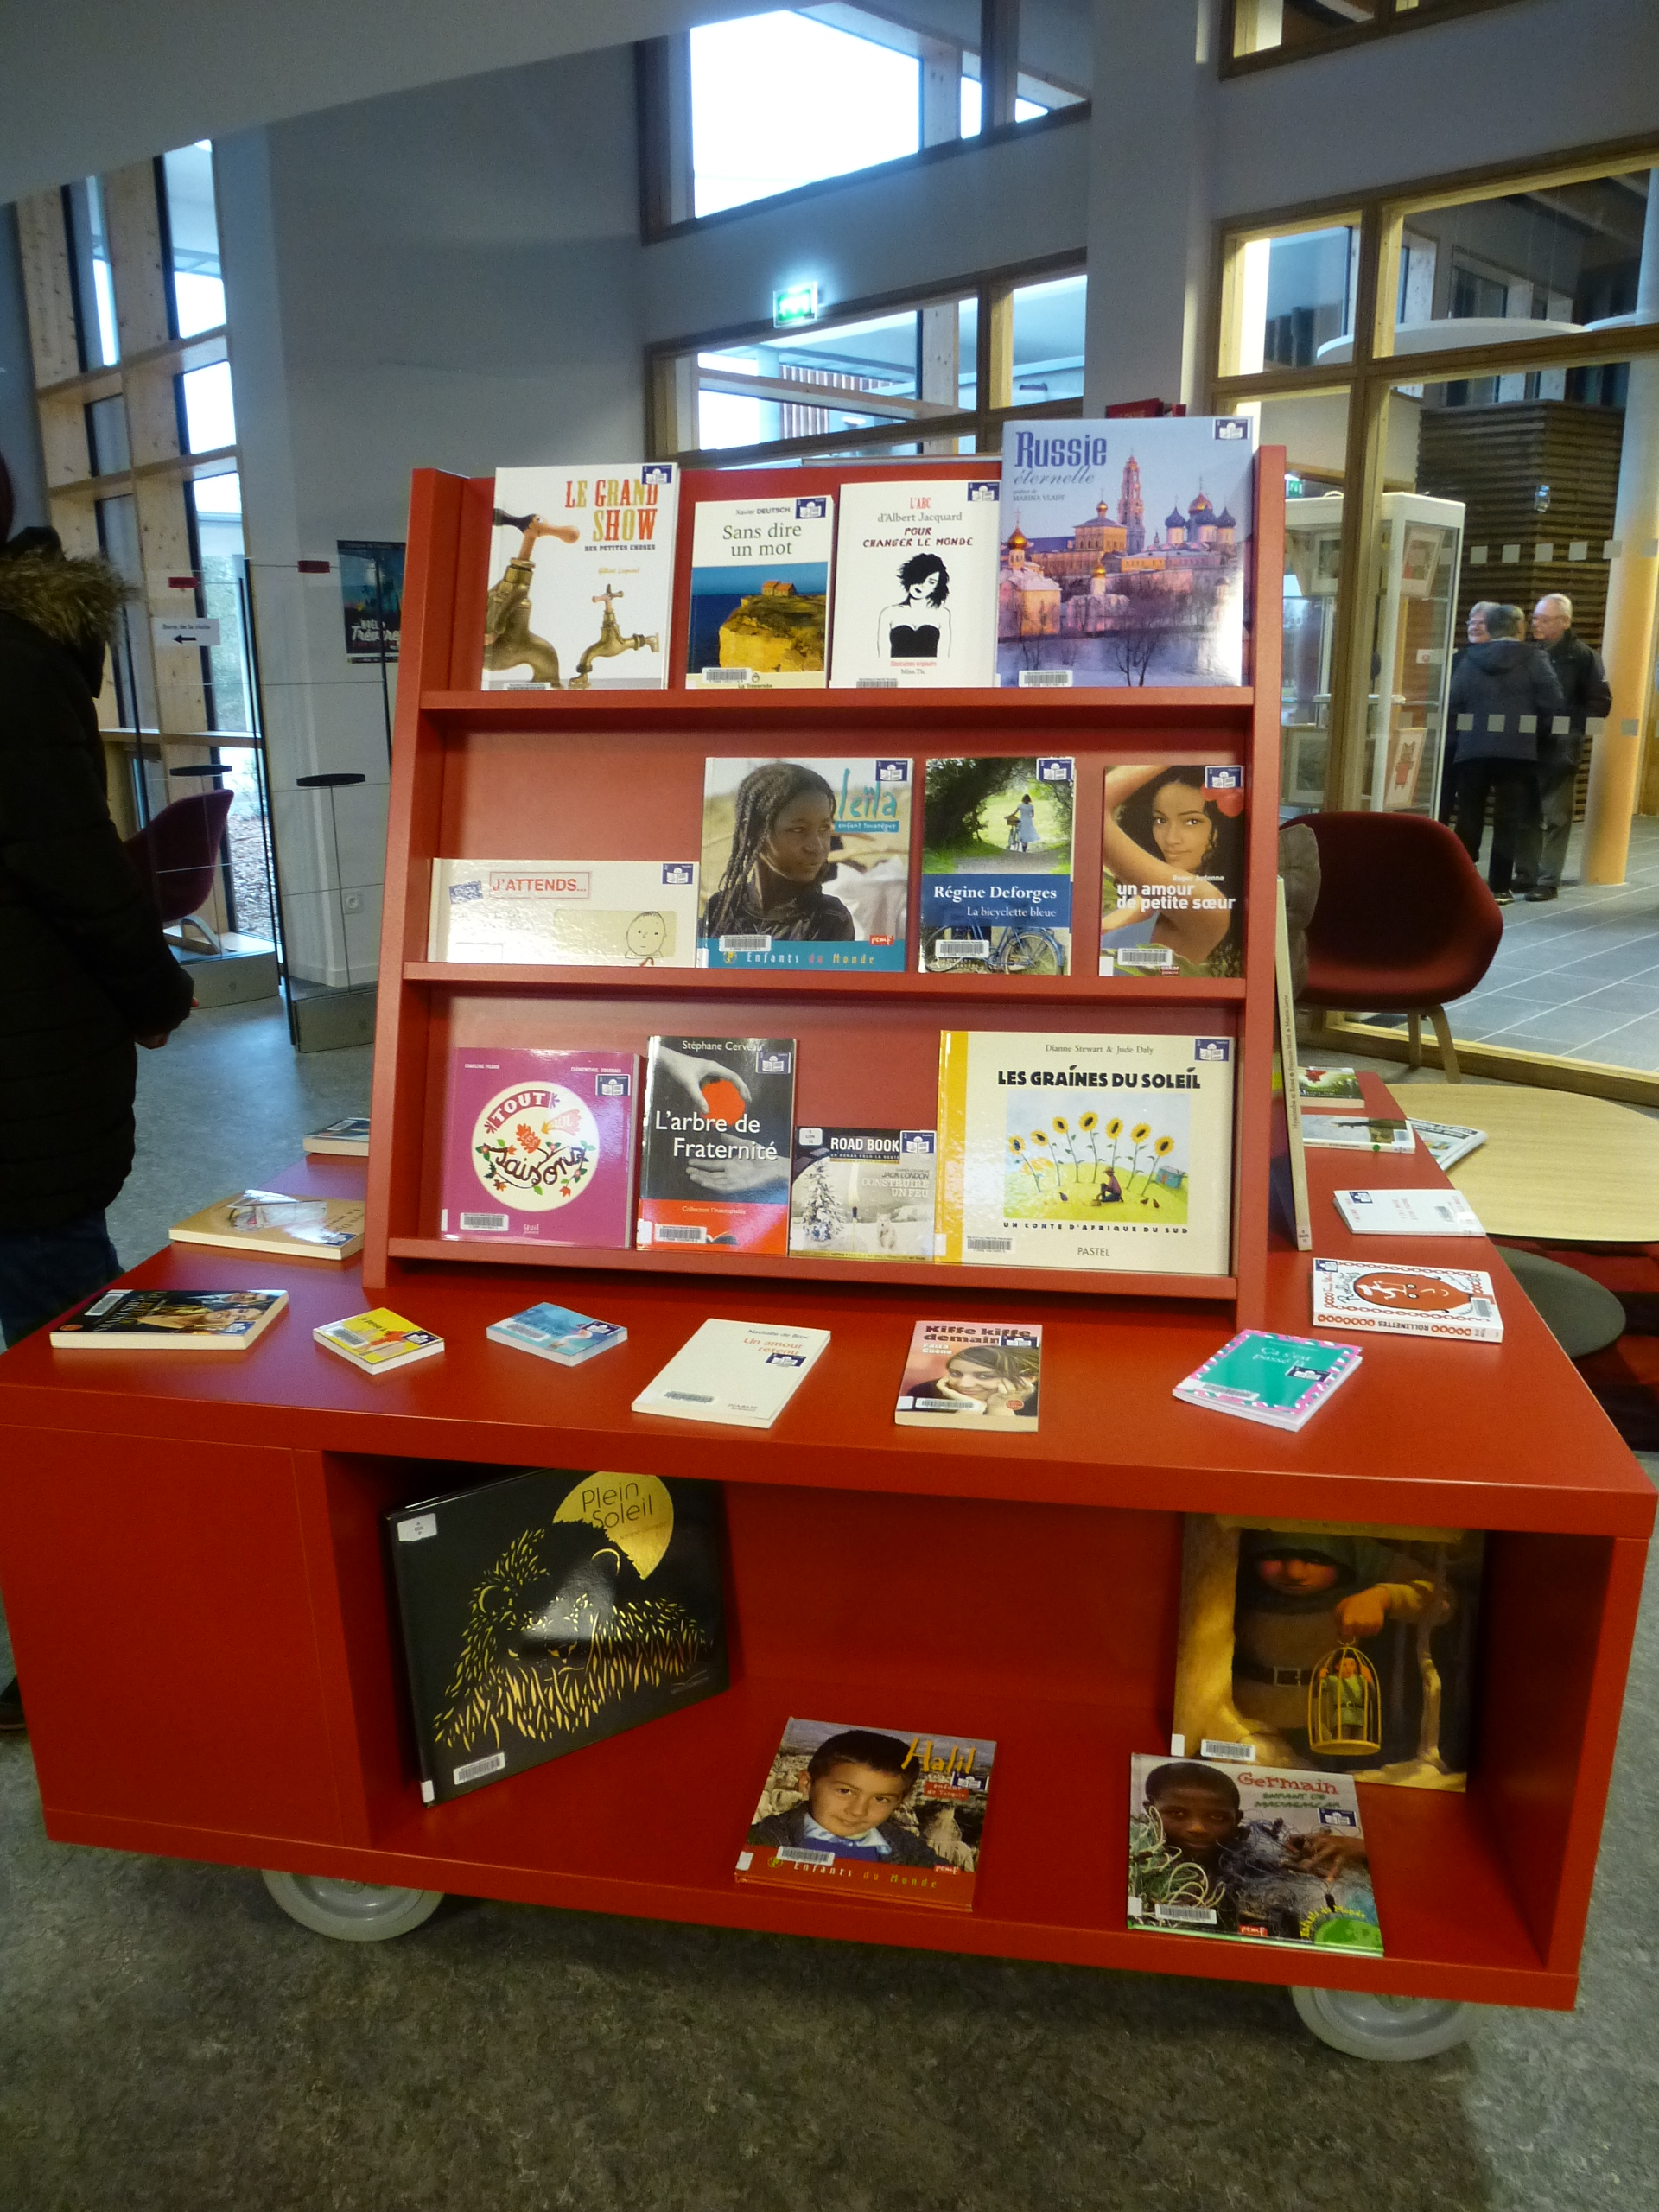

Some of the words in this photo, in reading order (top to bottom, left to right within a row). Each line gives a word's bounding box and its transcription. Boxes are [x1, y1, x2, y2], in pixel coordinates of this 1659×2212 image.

[1014, 431, 1107, 468] Russie
[1014, 465, 1095, 485] éternelle
[565, 480, 588, 508] LE
[594, 479, 658, 507] GRAND
[910, 497, 931, 510] L'ABC
[877, 513, 916, 523] d'Albert
[918, 512, 963, 524] Jacquard
[593, 508, 658, 542] SHOW
[722, 524, 761, 540] Sans
[767, 522, 802, 537] dire
[904, 527, 932, 537] POUR
[862, 538, 913, 548] CHANGER
[917, 537, 931, 547] LE
[936, 537, 974, 547] MONDE
[731, 544, 753, 557] un
[759, 542, 792, 556] mot
[838, 822, 861, 830] enfant
[933, 885, 986, 903] Régine
[990, 886, 1057, 903] Deforges
[1116, 884, 1137, 896] un
[1141, 884, 1195, 896] amour
[1116, 895, 1136, 909] de
[1141, 895, 1188, 912] petite
[1192, 898, 1236, 910] sœur
[967, 906, 978, 916] La
[981, 906, 1027, 919] bicyclette
[1030, 906, 1056, 917] bleue
[747, 952, 799, 963] Enfants
[832, 953, 875, 964] Monde
[683, 1040, 722, 1052] Stéphane
[1046, 1044, 1071, 1052] Dianne
[1075, 1045, 1103, 1053] Stewart
[1136, 1046, 1154, 1055] Daly
[998, 1071, 1027, 1085] LES
[1112, 1072, 1137, 1088] DU
[1141, 1071, 1200, 1089] SOLEIL
[491, 1091, 546, 1122] TOUT
[656, 1110, 728, 1132] L'arbre
[735, 1114, 760, 1133] de
[673, 1136, 778, 1160] Fraternité
[830, 1137, 863, 1150] ROAD
[867, 1139, 899, 1152] BOOK
[862, 1178, 930, 1187] CONSTRUIRE
[891, 1188, 907, 1197] UN
[908, 1189, 929, 1198] FEU
[1069, 1224, 1137, 1232] D'AFRIQUE
[1077, 1247, 1110, 1257] PASTEL
[925, 1325, 976, 1335] Kiffe
[981, 1328, 1031, 1338] kiffe
[1377, 1320, 1429, 1332] ROLLINETTES
[763, 1340, 804, 1350] amour
[924, 1333, 1000, 1344] demain
[758, 1346, 799, 1356] retenu
[582, 1482, 639, 1513] Plein
[593, 1494, 652, 1529] Soleil
[900, 1737, 976, 1774] Halil
[1237, 1772, 1339, 1795] Germain
[794, 1862, 853, 1878] Enfants
[863, 1871, 880, 1881] du
[890, 1873, 938, 1889] Monde
